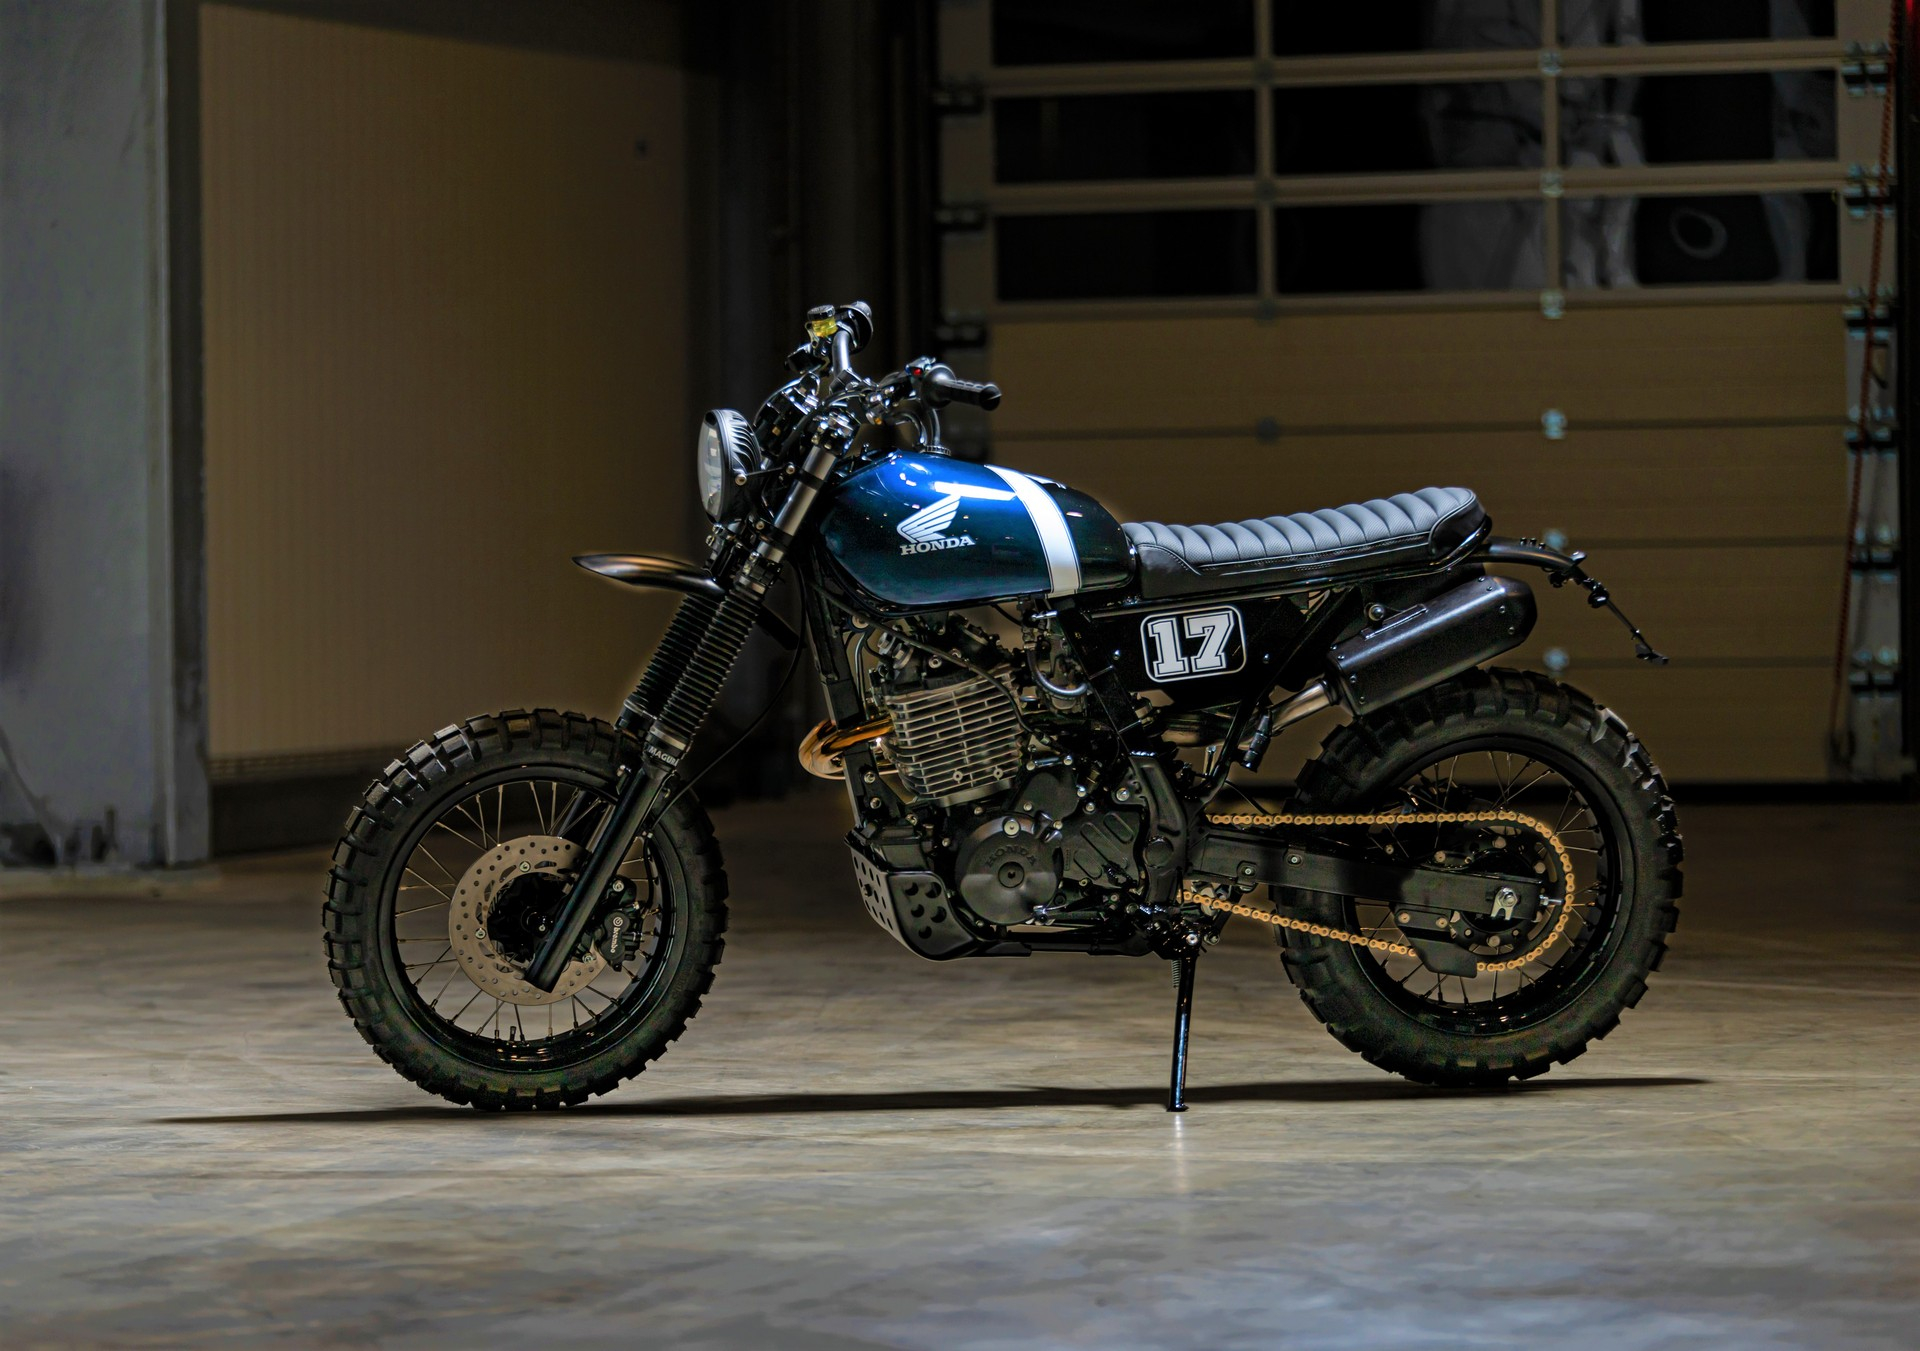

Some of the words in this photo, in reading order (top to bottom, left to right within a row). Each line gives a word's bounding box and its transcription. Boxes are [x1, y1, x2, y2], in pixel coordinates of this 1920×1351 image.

[900, 535, 976, 556] HONDA
[1147, 610, 1235, 677] 17
[985, 845, 1036, 868] HONDA
[610, 927, 621, 954] brembo
